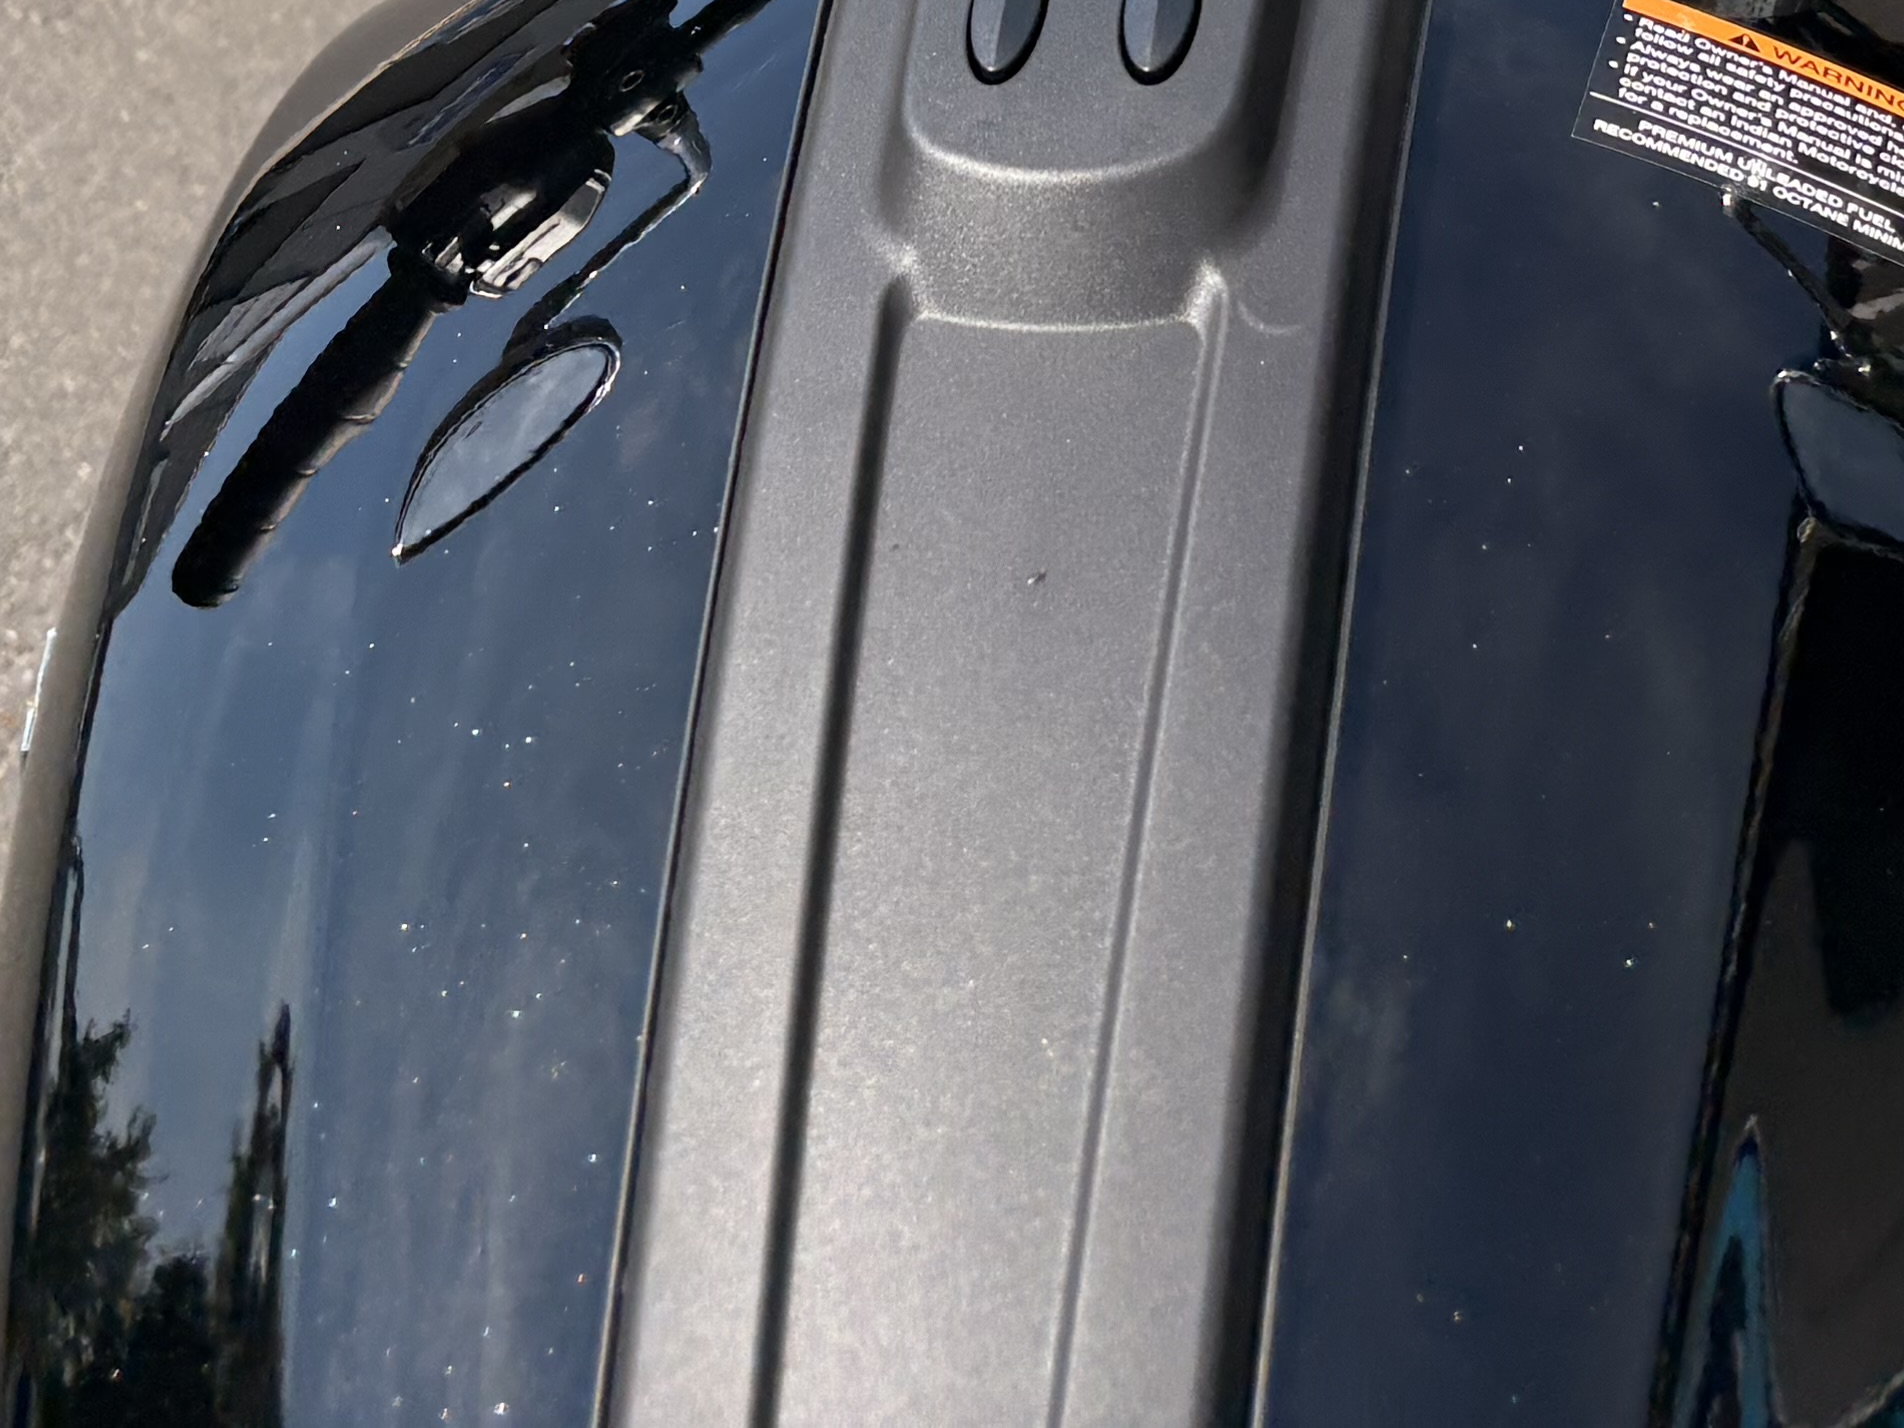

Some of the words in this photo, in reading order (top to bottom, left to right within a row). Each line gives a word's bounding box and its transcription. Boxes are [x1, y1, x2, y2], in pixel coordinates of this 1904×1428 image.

[1625, 52, 1728, 95] protection
[1731, 91, 1772, 112] and
[1775, 107, 1875, 156] protective
[1629, 40, 1702, 73] Always
[1705, 68, 1756, 94] wear
[1758, 89, 1785, 106] an
[1788, 101, 1883, 147] approved
[1634, 28, 1694, 55] follow
[1697, 50, 1722, 67] all
[1725, 61, 1786, 92] safety
[1638, 17, 1691, 43] Read
[1694, 37, 1774, 75] Owner's
[1778, 67, 1851, 107] Manual
[1618, 88, 1649, 105] for
[1650, 101, 1665, 112] a
[1668, 104, 1799, 164] replacement.
[1619, 77, 1696, 111] contact
[1699, 106, 1726, 122] an
[1730, 115, 1793, 148] Indian
[1623, 63, 1639, 77] If
[1642, 71, 1689, 94] your
[1691, 88, 1773, 127] Owner's
[1777, 120, 1851, 160] Manual
[1855, 154, 1873, 170] is
[1637, 120, 1734, 164] PREMIUM
[1592, 119, 1745, 183] RECOMMENDED
[1772, 185, 1849, 227] OCTANE
